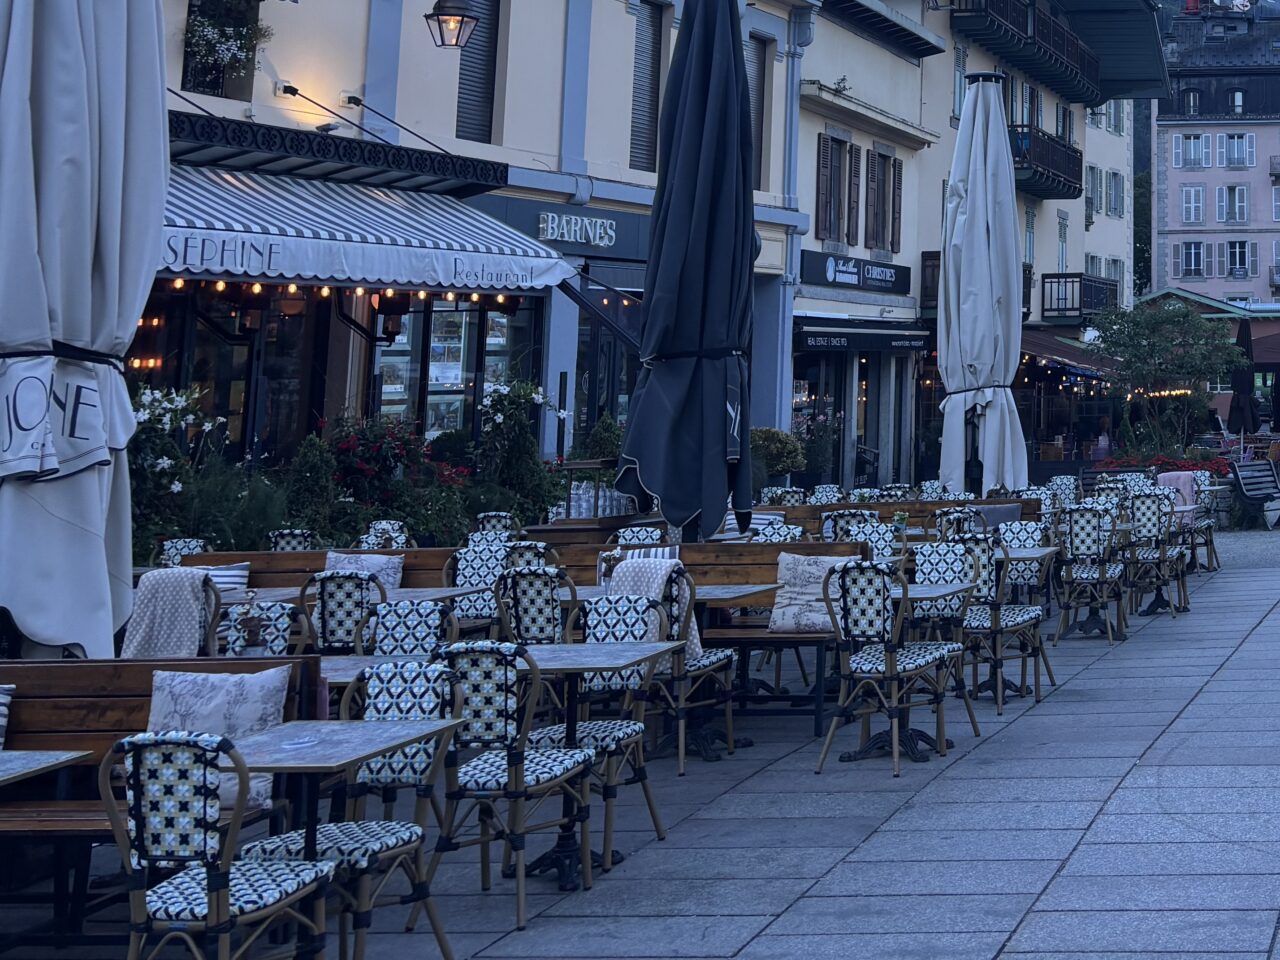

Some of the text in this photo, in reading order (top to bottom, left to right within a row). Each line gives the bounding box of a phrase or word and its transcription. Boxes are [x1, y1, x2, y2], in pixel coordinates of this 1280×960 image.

[545, 212, 616, 247] BARNES
[162, 233, 281, 271] SÉPHINE
[453, 257, 534, 283] Restaurant
